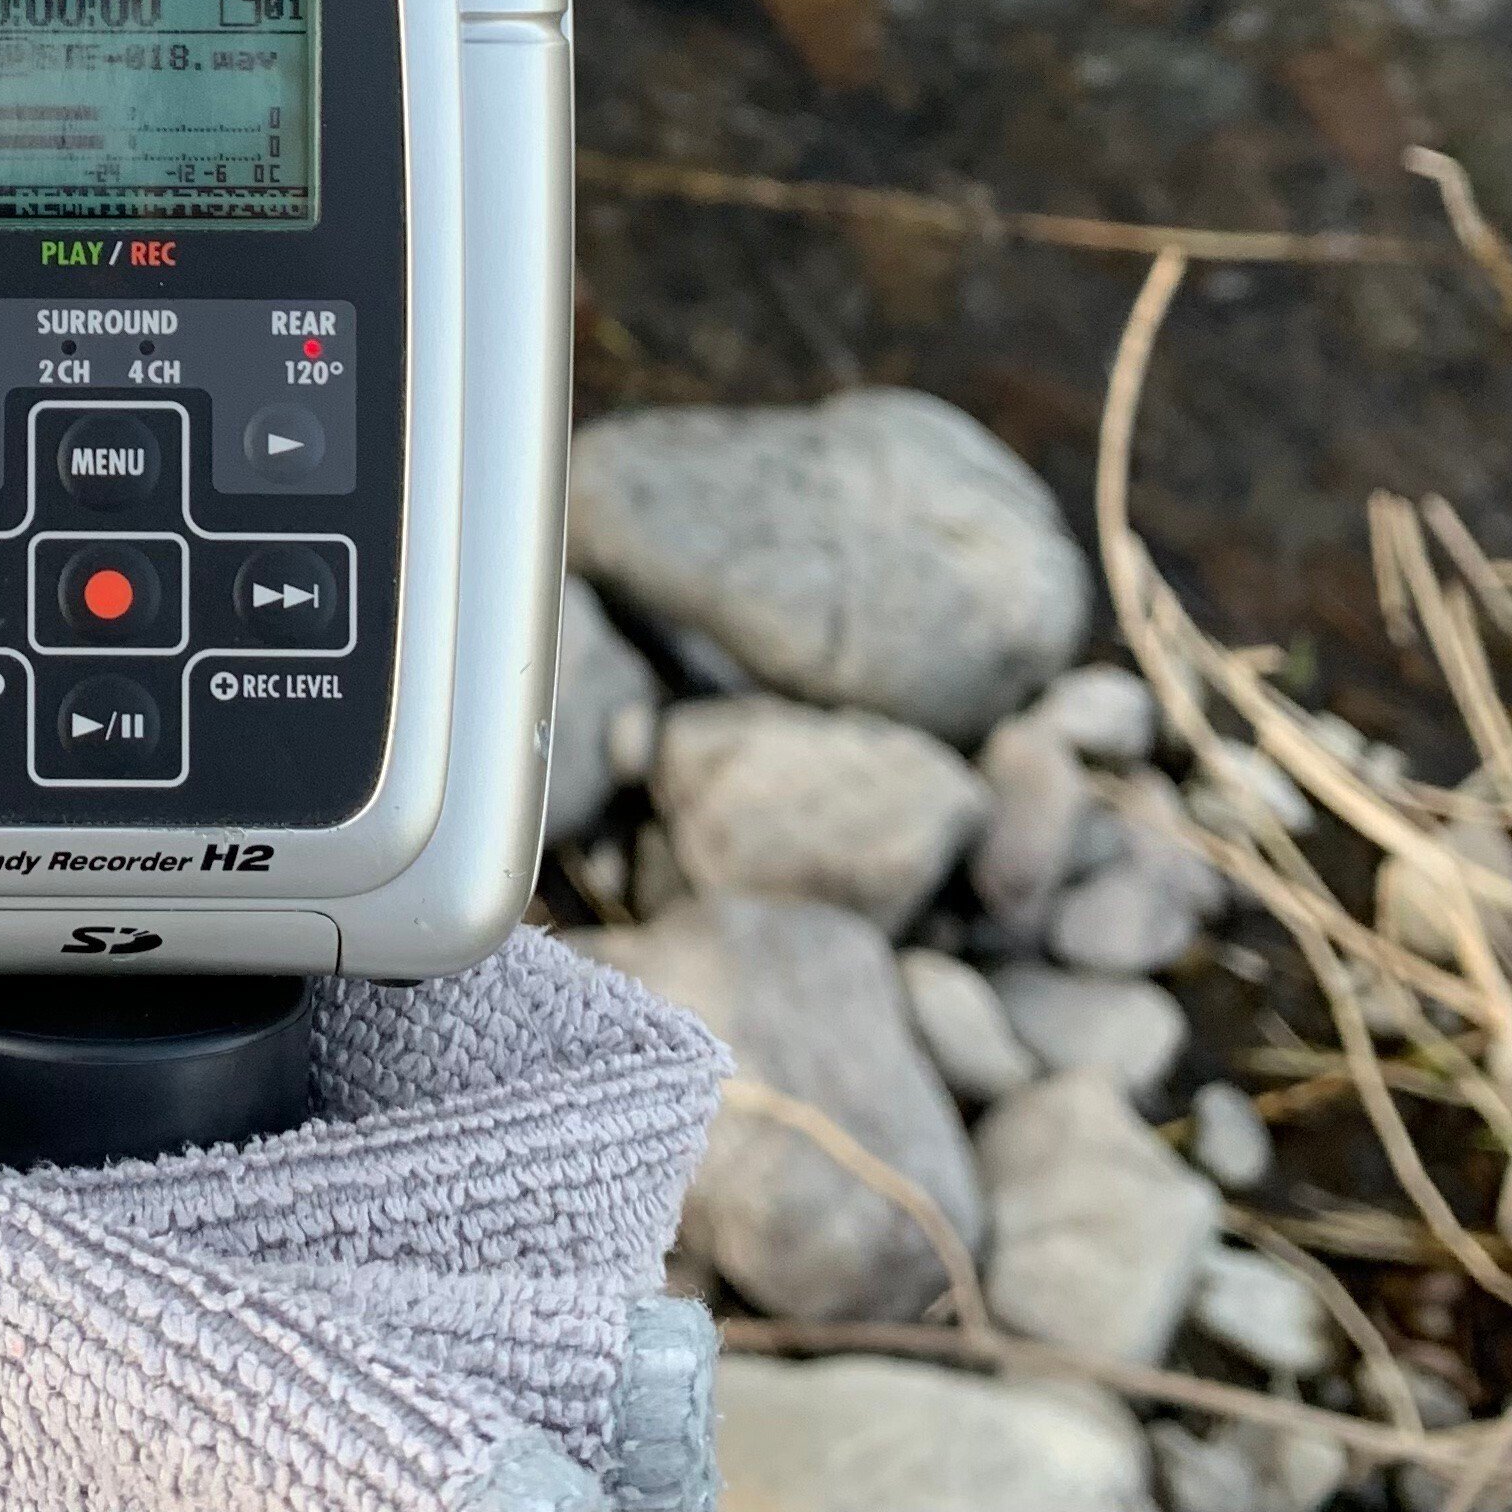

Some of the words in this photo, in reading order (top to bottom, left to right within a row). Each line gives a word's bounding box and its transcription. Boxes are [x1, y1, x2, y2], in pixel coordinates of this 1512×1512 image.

[41, 242, 103, 265] PLAY
[131, 242, 176, 266] REC
[37, 309, 178, 335] SURROUND
[271, 311, 336, 336] REAR
[285, 360, 344, 384] 120°
[71, 448, 144, 475] MENU
[243, 675, 281, 698] REC
[286, 675, 342, 699] LEVEL
[48, 851, 192, 872] Recorder
[201, 844, 275, 872] H2
